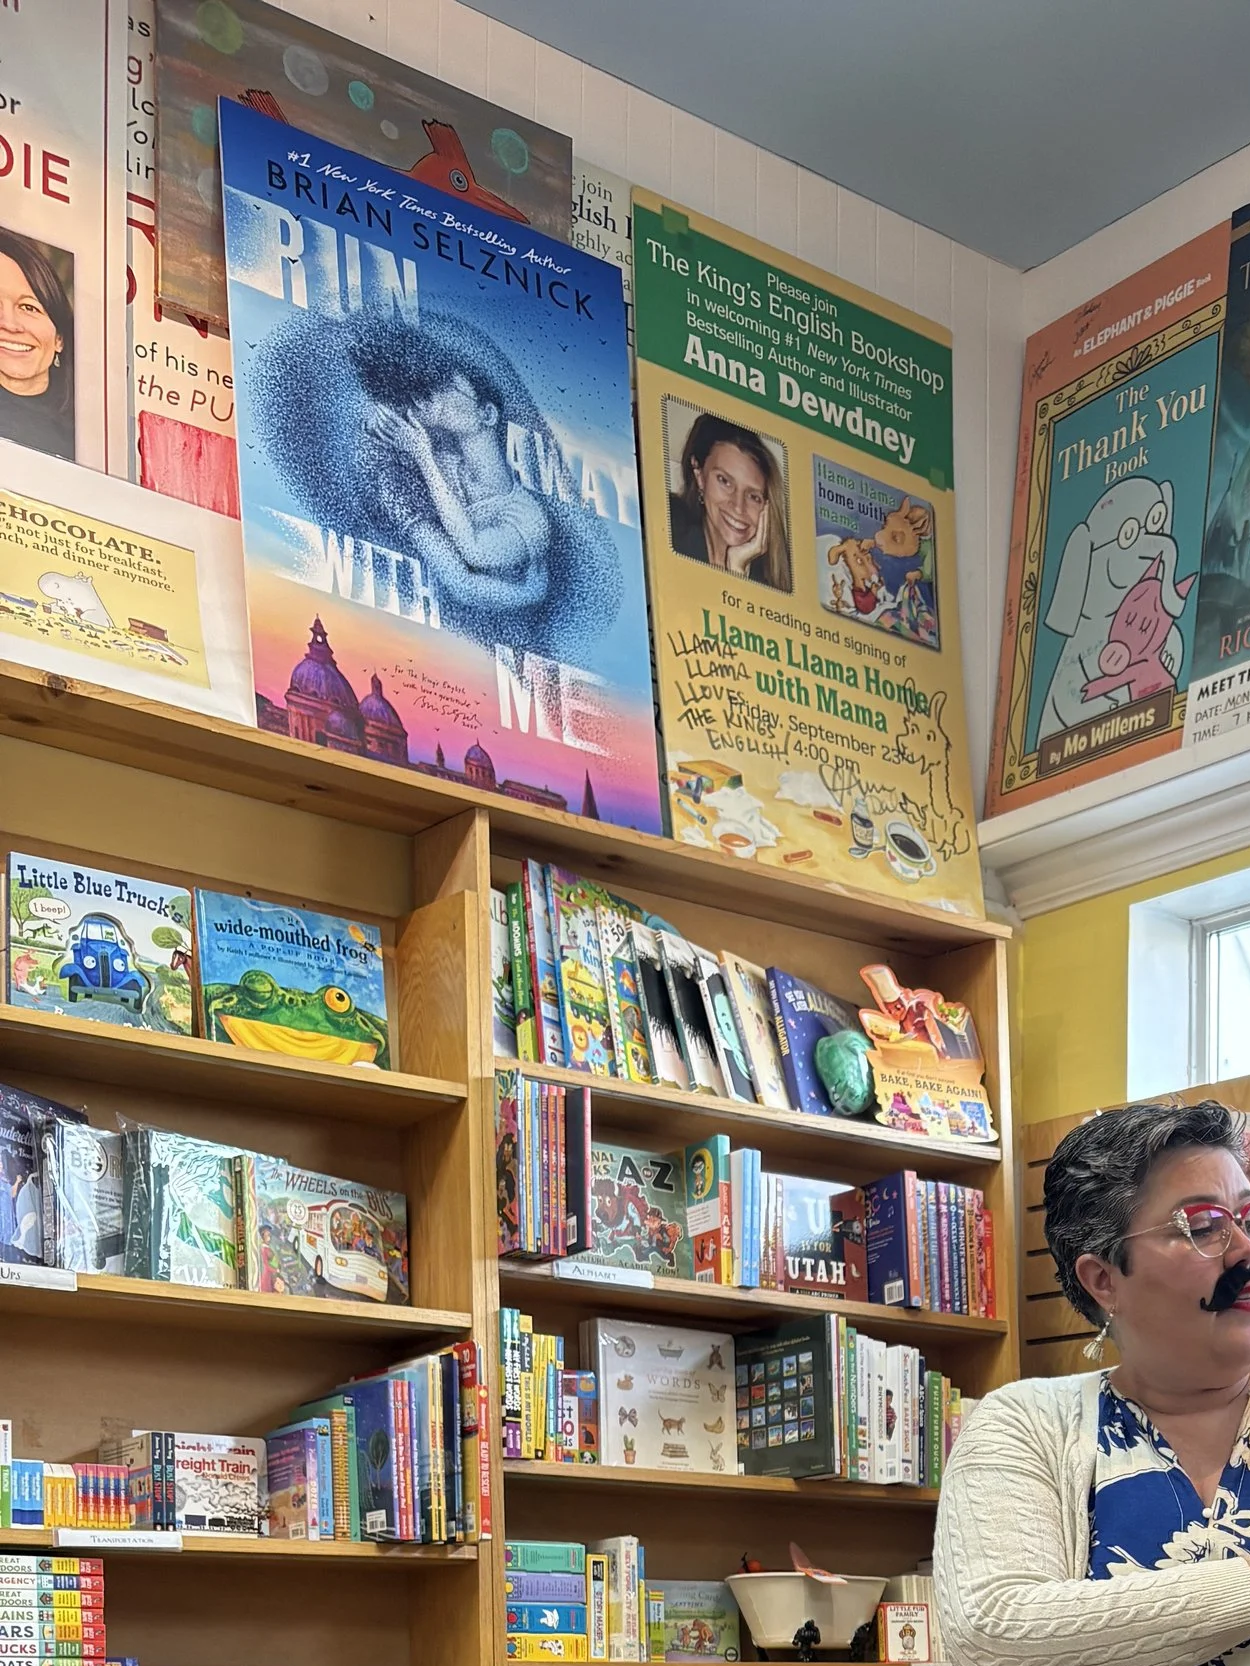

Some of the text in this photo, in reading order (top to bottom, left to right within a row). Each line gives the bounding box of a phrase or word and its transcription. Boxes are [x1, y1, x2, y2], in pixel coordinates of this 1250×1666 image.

[267, 159, 595, 321] BRIAN SELZNICK
[287, 150, 572, 275] #1 New York Times Bestselling Author
[270, 205, 420, 326] RUN
[766, 273, 838, 317] Please join
[647, 238, 944, 393] The King's English Bookshop
[687, 288, 911, 400] in welcoming #1 New York Times
[683, 333, 916, 464] Anna Dewdney
[686, 311, 912, 421] Bestselling Author and Illustrator
[1116, 384, 1149, 414] The
[1057, 384, 1206, 482] Thank You
[1104, 446, 1149, 485] Book
[505, 421, 640, 528] AWAY
[818, 483, 887, 522] home with
[17, 524, 167, 581] not just for breakfast,
[33, 542, 175, 593] and dinner anymore.
[312, 525, 441, 630] WITH
[701, 608, 929, 714] Llama Llama Home
[721, 590, 907, 668] for a reading and signing of
[495, 644, 612, 757] ME
[756, 670, 888, 734] with Mama
[1197, 675, 1234, 701] MEET
[793, 740, 860, 775] 4:00 pm
[17, 864, 183, 923] Little Blue Truck's
[214, 920, 330, 952] wide-mouthed
[336, 939, 368, 964] frog
[880, 1073, 983, 1099] BAKE, BAKE AGAIN!
[786, 1256, 846, 1285] UTAH
